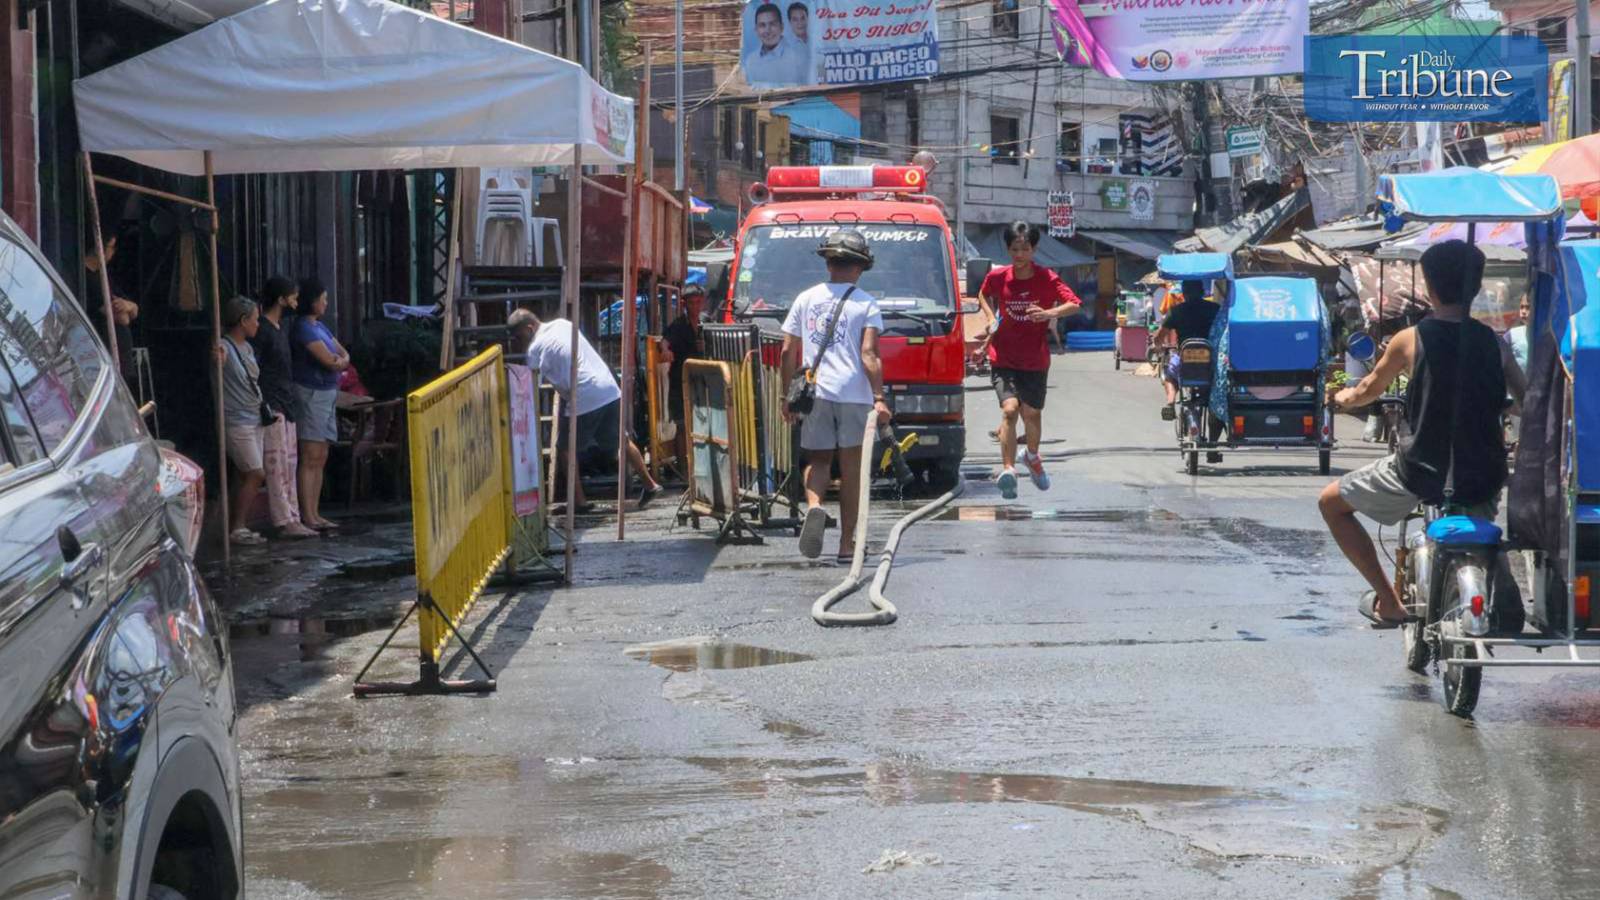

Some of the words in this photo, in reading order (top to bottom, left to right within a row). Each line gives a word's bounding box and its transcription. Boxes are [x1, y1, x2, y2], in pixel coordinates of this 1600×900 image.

[822, 27, 861, 40] STO
[824, 53, 866, 68] ALLO
[870, 46, 930, 66] ARCEO
[827, 66, 874, 83] MOTI
[878, 59, 938, 79] ARCEO
[1049, 205, 1073, 217] BARBER
[1052, 218, 1072, 227] SHOP
[864, 230, 929, 243] PUMPER
